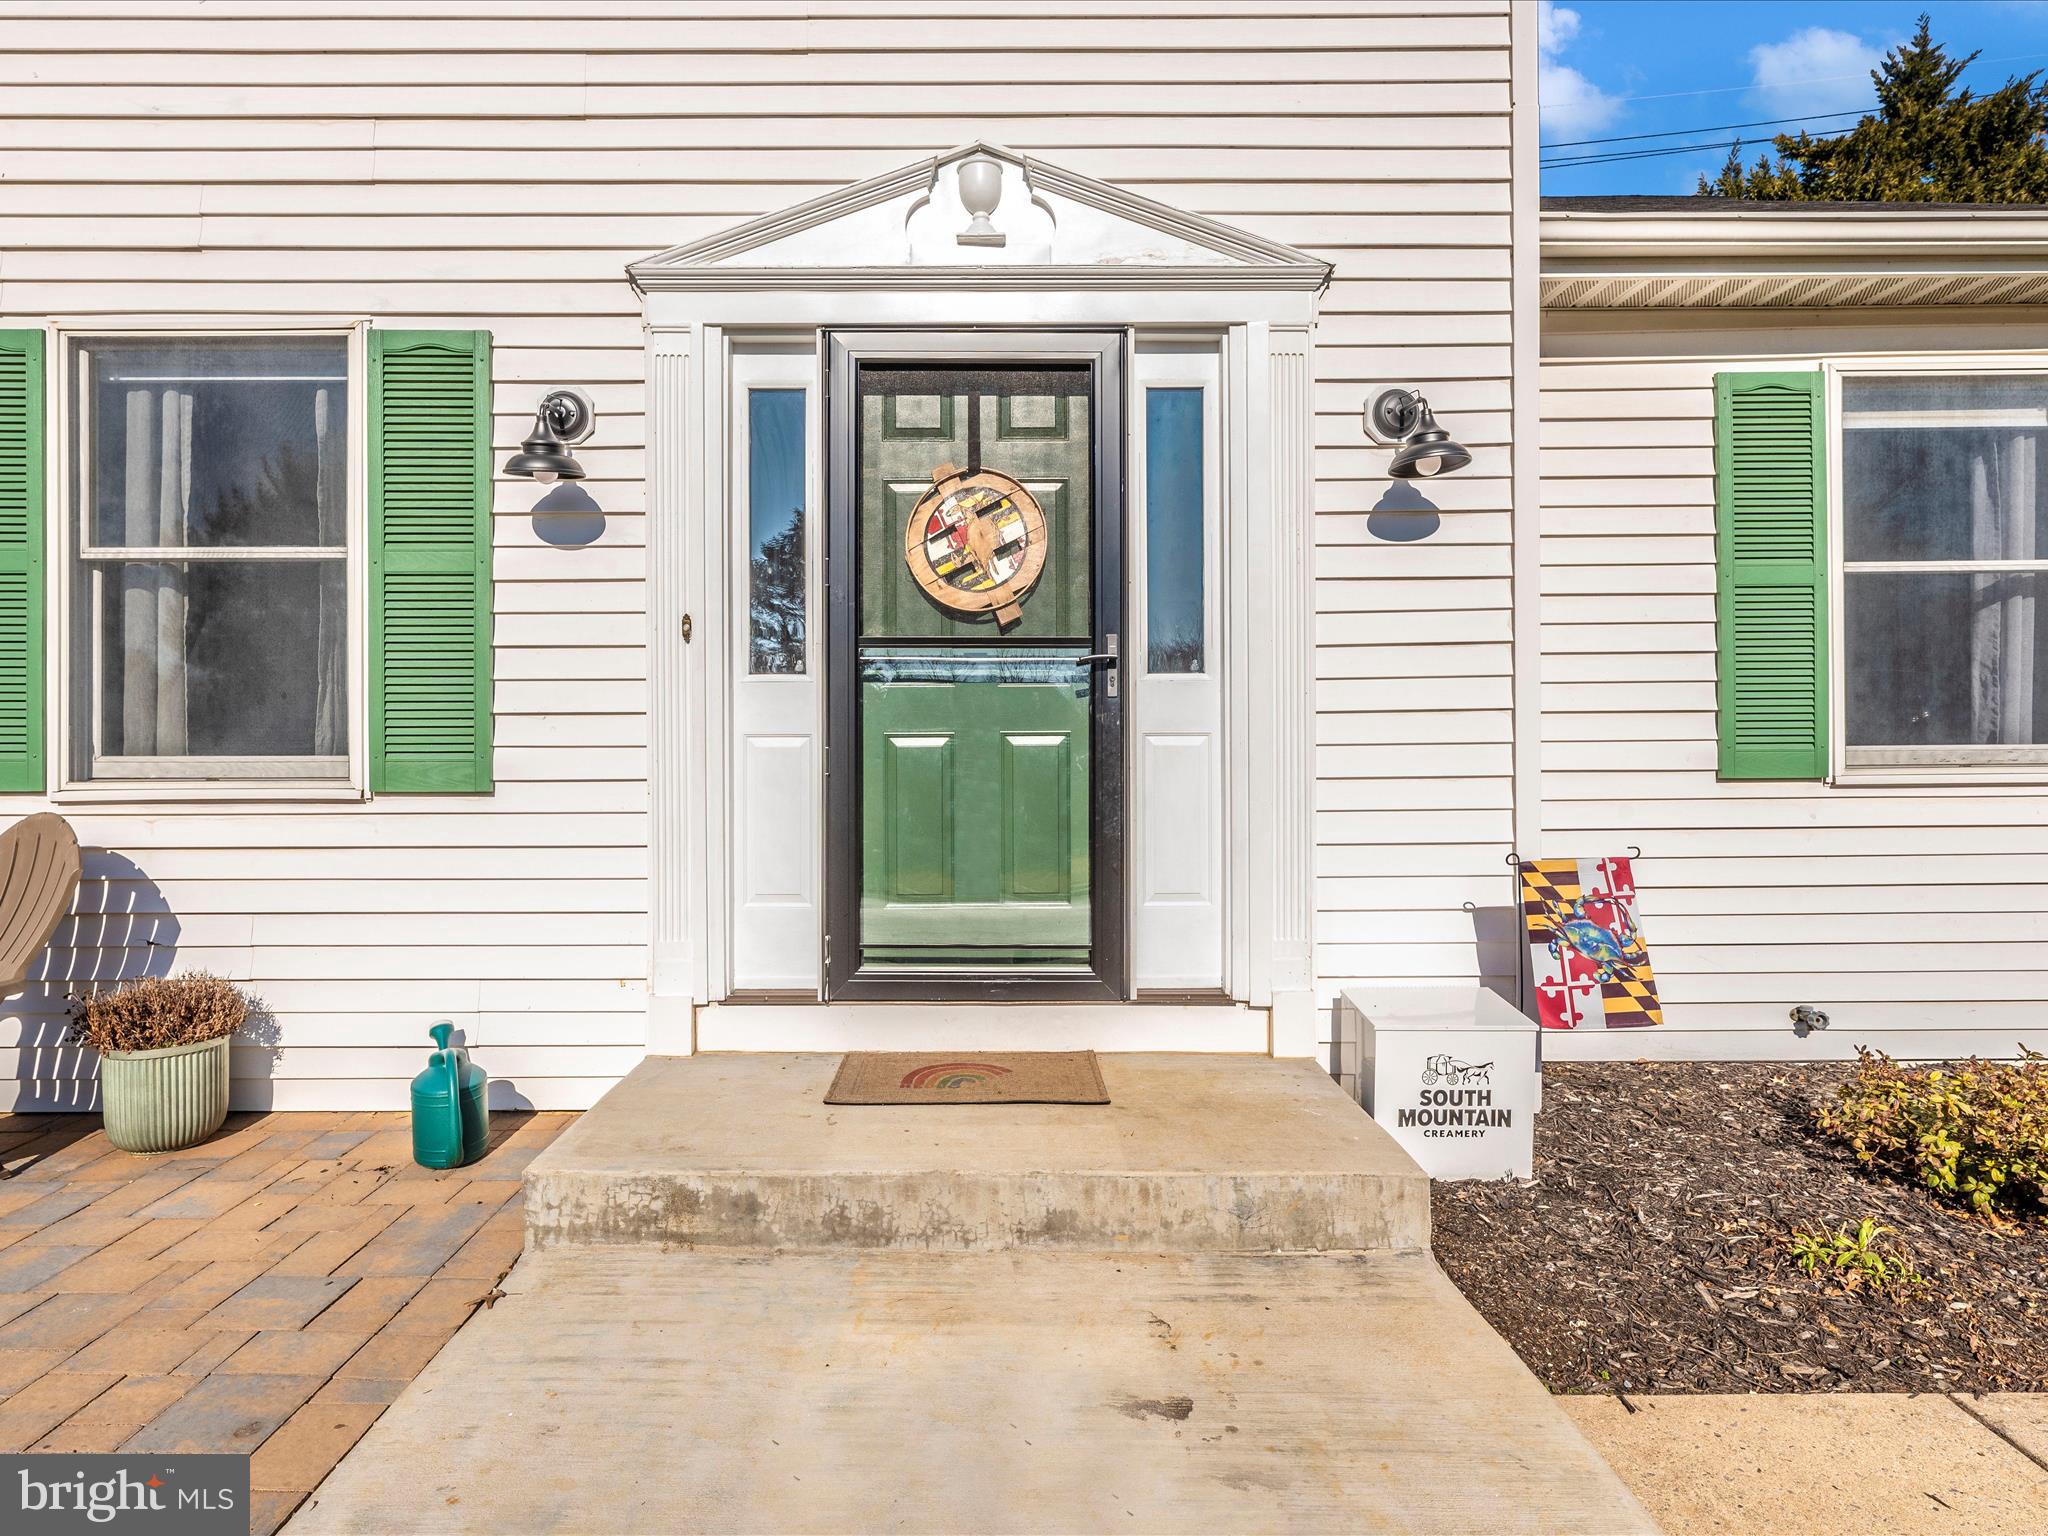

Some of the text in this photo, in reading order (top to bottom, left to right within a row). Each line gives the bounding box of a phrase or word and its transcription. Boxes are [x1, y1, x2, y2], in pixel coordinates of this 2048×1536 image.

[1420, 1089, 1492, 1106] SOUTH
[1398, 1109, 1512, 1128] MOUNTAIN
[1423, 1129, 1486, 1138] CREAMERY
